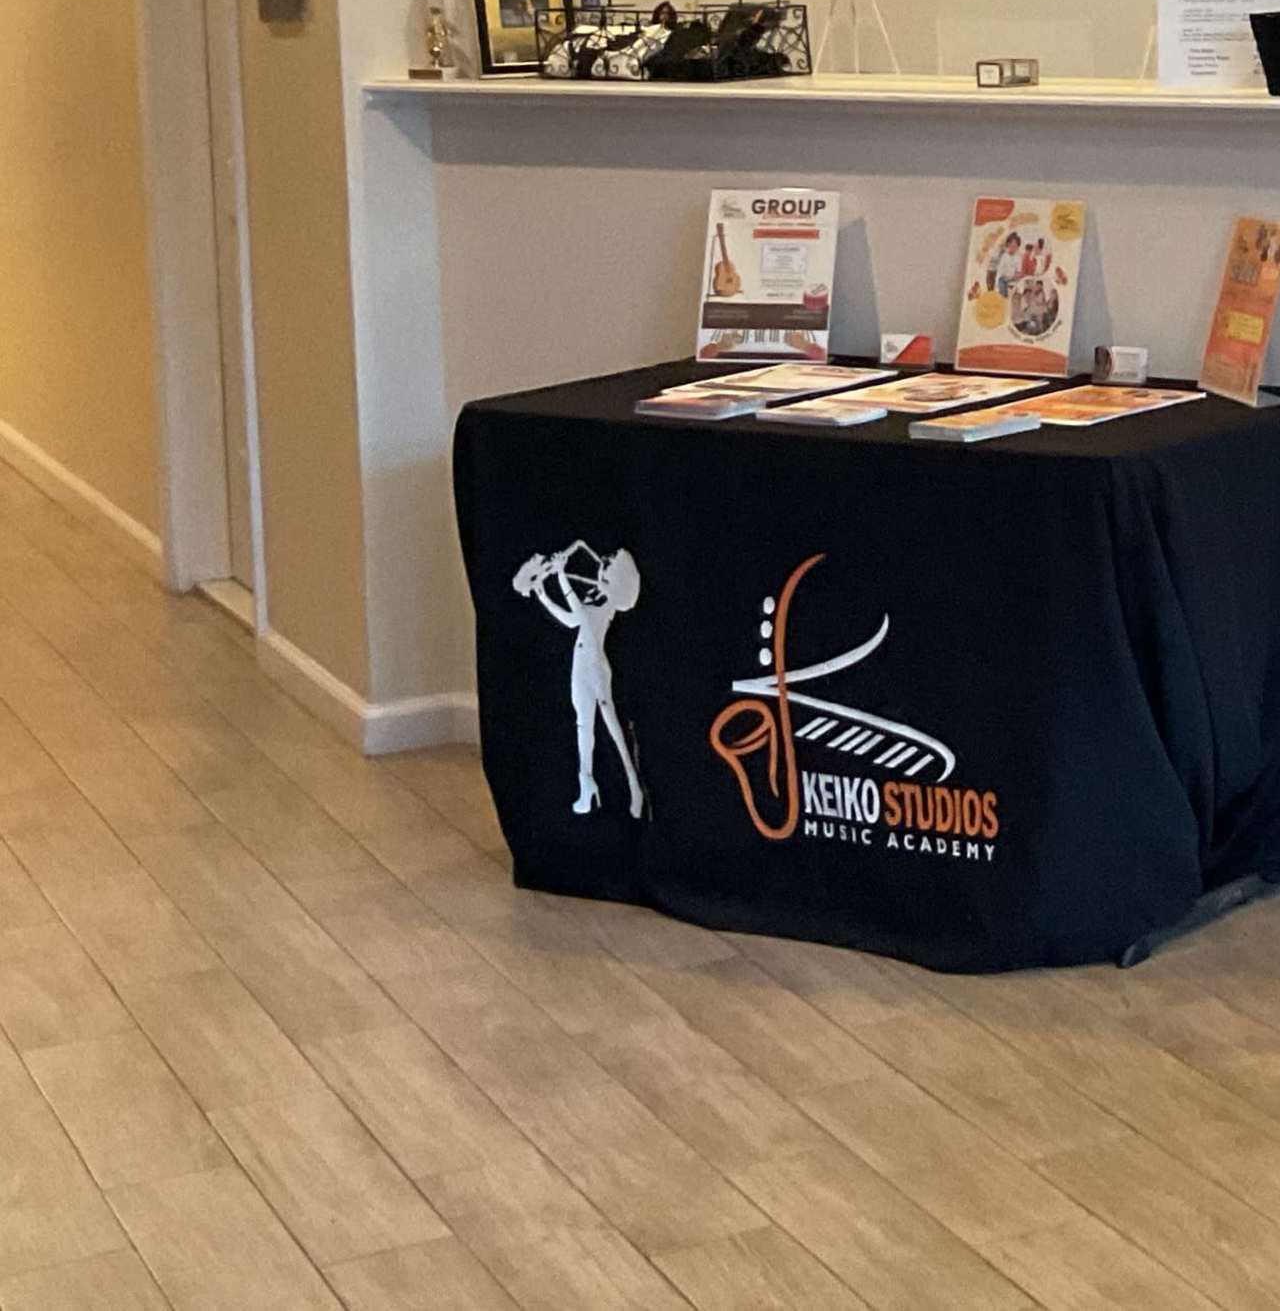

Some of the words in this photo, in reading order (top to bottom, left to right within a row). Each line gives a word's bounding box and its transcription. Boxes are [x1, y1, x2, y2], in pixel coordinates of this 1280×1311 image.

[751, 199, 827, 216] GROUP
[802, 770, 880, 824] KEIKO
[883, 781, 999, 838] STUDIOS
[804, 820, 872, 845] MUSIC
[886, 832, 996, 861] ACADEMY
